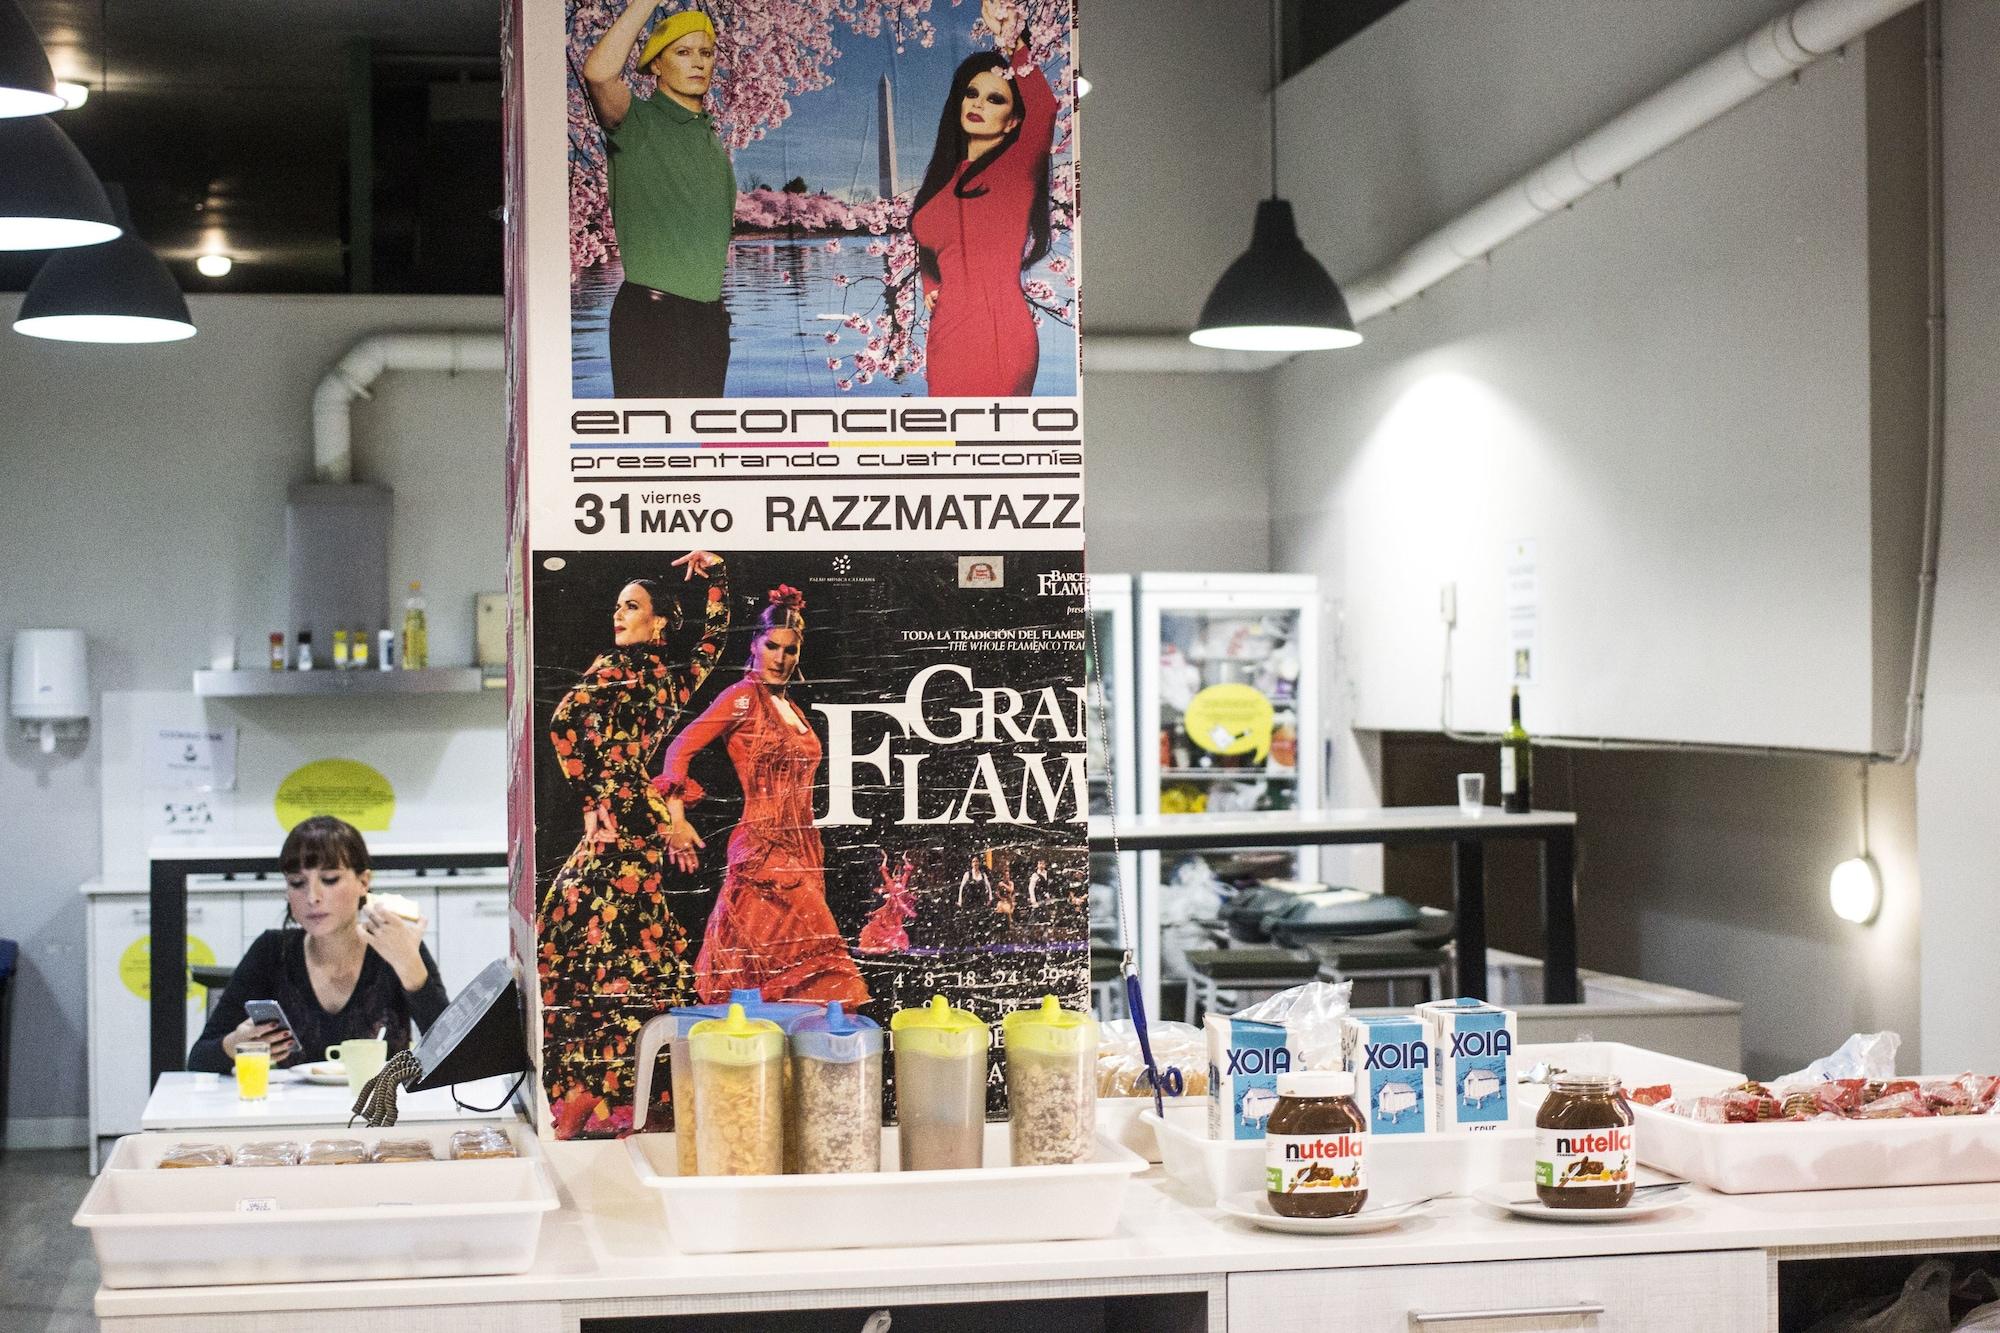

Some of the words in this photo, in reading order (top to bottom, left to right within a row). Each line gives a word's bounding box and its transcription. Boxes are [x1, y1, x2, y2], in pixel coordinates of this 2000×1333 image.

[571, 410, 672, 435] en
[691, 402, 1079, 434] concierto
[571, 452, 840, 472] presentando
[857, 449, 1083, 467] cuatricomía
[641, 490, 701, 504] viernes
[574, 493, 630, 534] 31
[641, 509, 734, 534] MAYO
[901, 630, 935, 641] TODA
[937, 630, 951, 641] LA
[953, 628, 1013, 641] TRADICIÓN
[1018, 629, 1041, 641] DEL
[948, 641, 967, 651] THE
[970, 641, 1005, 651] WHOLE
[1007, 640, 1061, 651] FLAMENCO
[1364, 1041, 1429, 1070] XOIA
[1450, 1029, 1512, 1058] XOIA
[1226, 1047, 1291, 1075] XOIA
[1285, 1135, 1363, 1160] nutella
[1556, 1129, 1631, 1154] nutella
